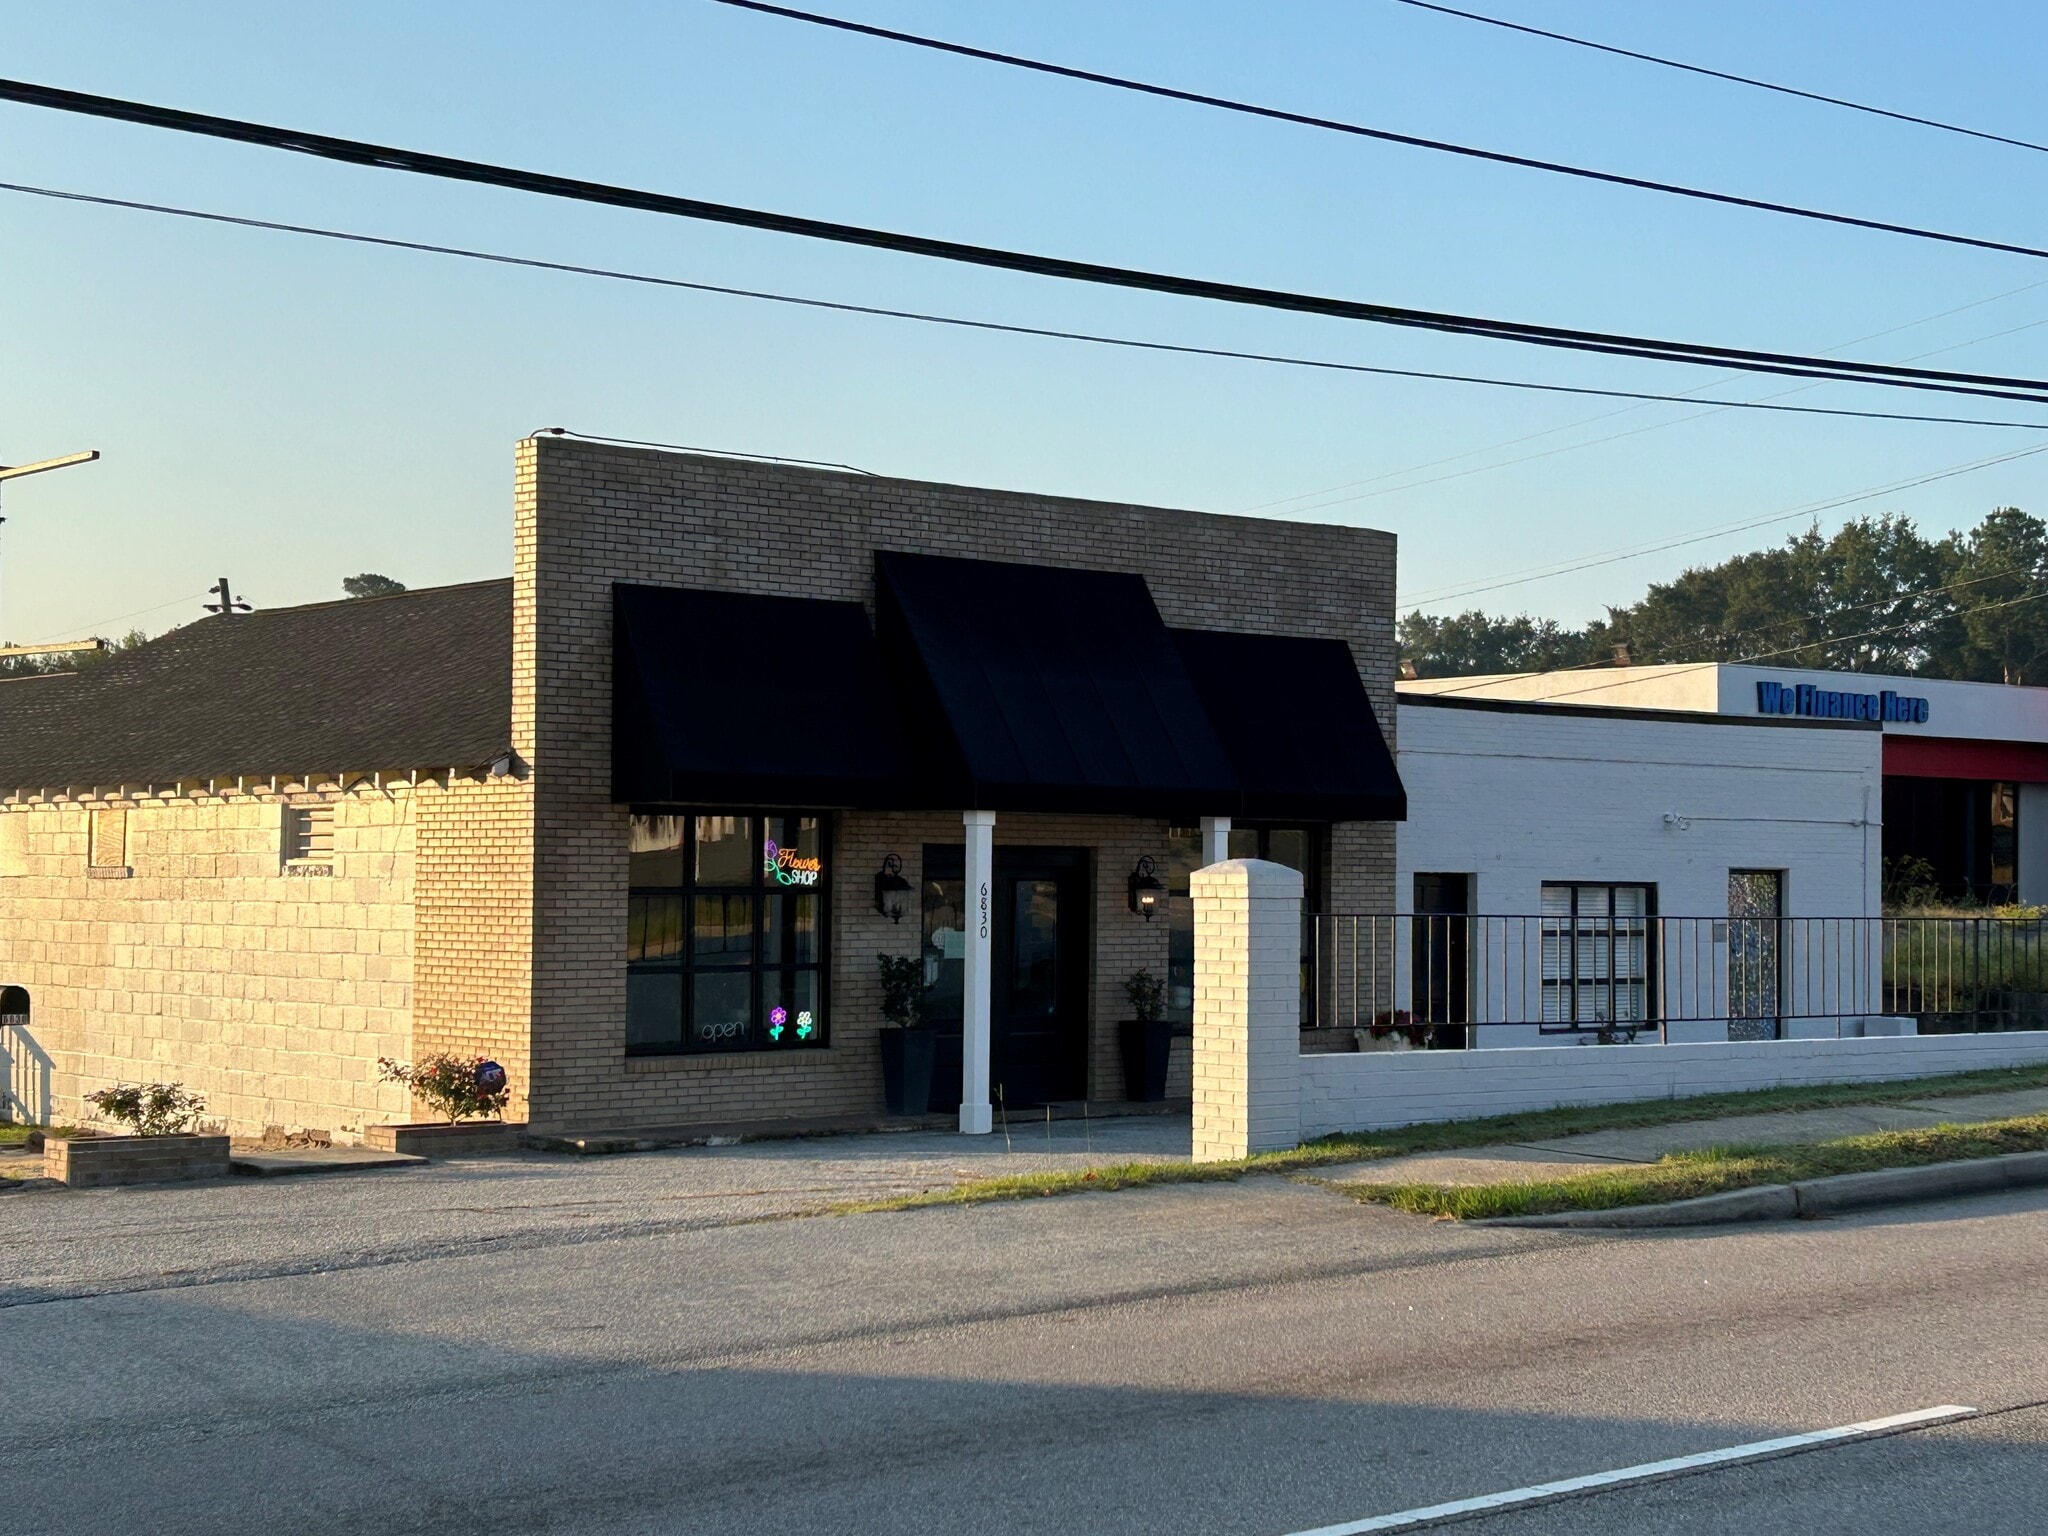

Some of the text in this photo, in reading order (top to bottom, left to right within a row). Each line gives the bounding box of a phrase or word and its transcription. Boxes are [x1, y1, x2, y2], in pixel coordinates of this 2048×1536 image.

[1757, 681, 1929, 723] We Finance Here
[778, 848, 821, 871] Flower
[791, 869, 818, 885] SHOP
[980, 882, 988, 939] 6830
[701, 1021, 745, 1042] open
